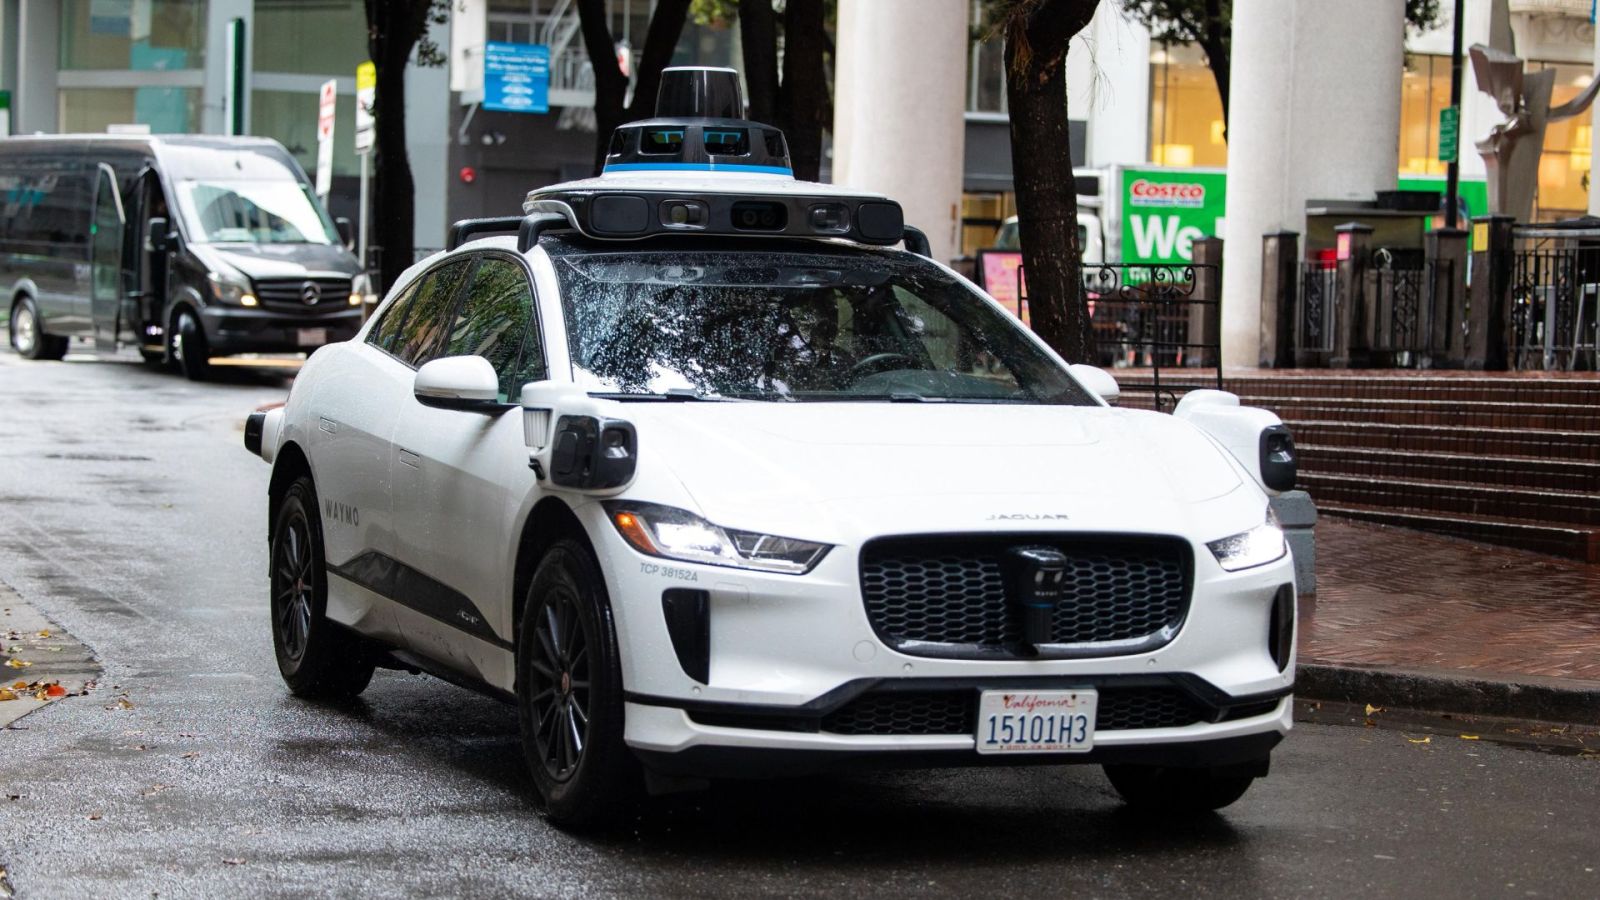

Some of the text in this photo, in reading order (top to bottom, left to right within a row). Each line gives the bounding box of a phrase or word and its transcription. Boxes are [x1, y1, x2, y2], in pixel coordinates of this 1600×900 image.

[1129, 215, 1204, 261] We
[325, 499, 359, 527] WAYMO
[640, 562, 699, 582] TCP 38152A
[1003, 694, 1076, 712] California
[986, 714, 1088, 744] 15101H3
